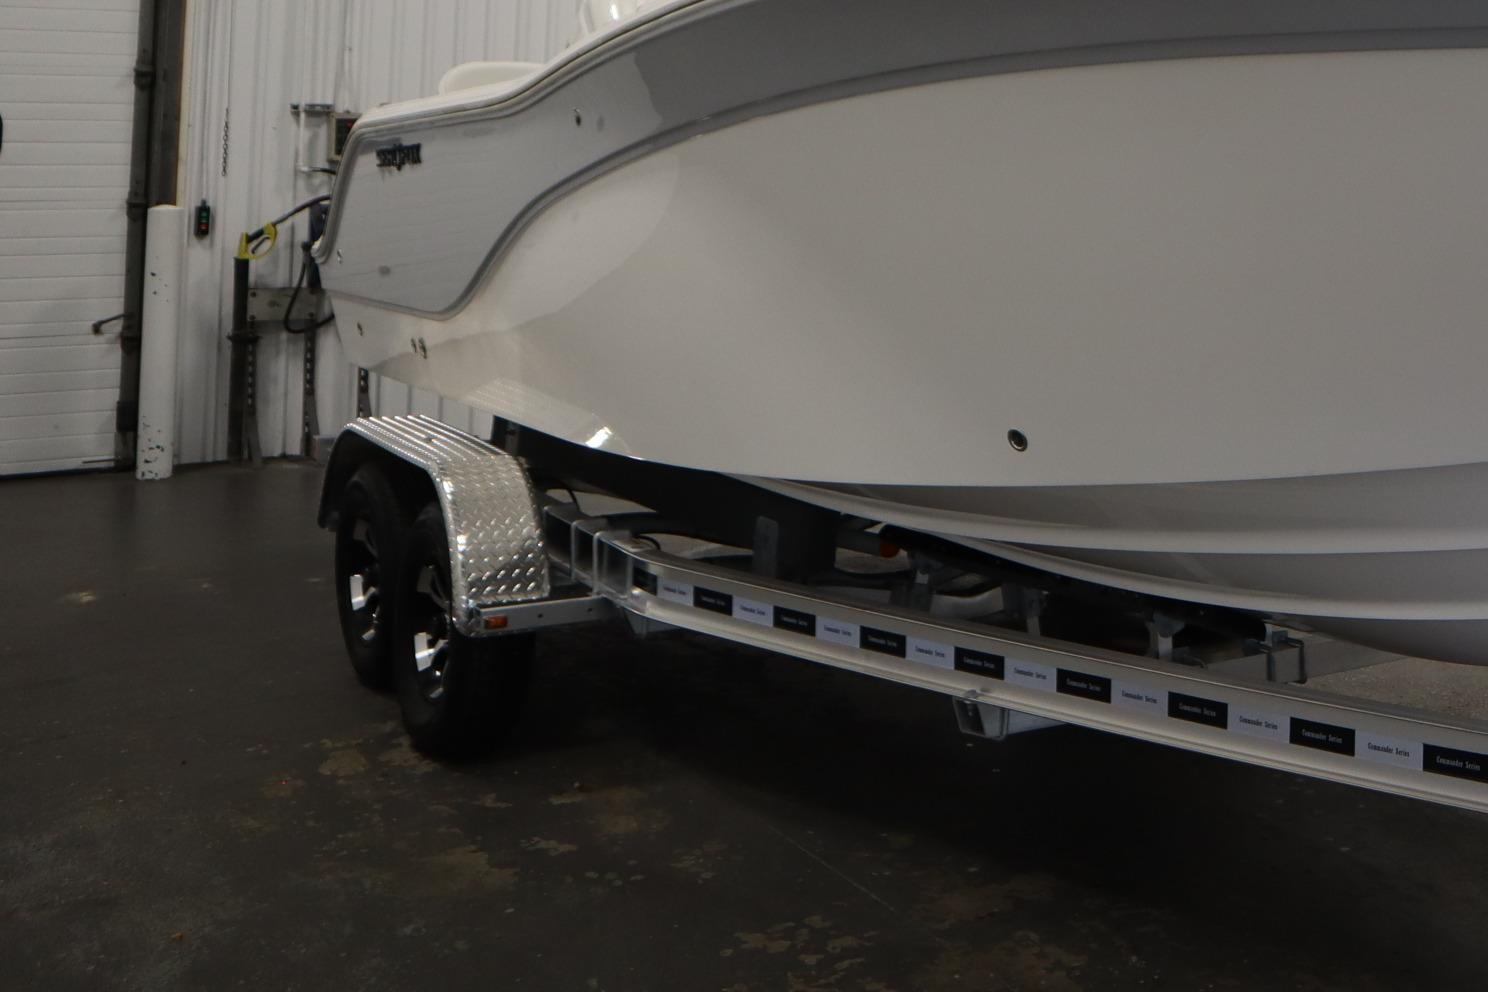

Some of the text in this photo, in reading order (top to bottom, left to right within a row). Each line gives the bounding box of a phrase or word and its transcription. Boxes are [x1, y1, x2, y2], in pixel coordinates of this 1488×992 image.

[1368, 742, 1410, 757] Commander Series
[1436, 755, 1480, 771] Commander Series
